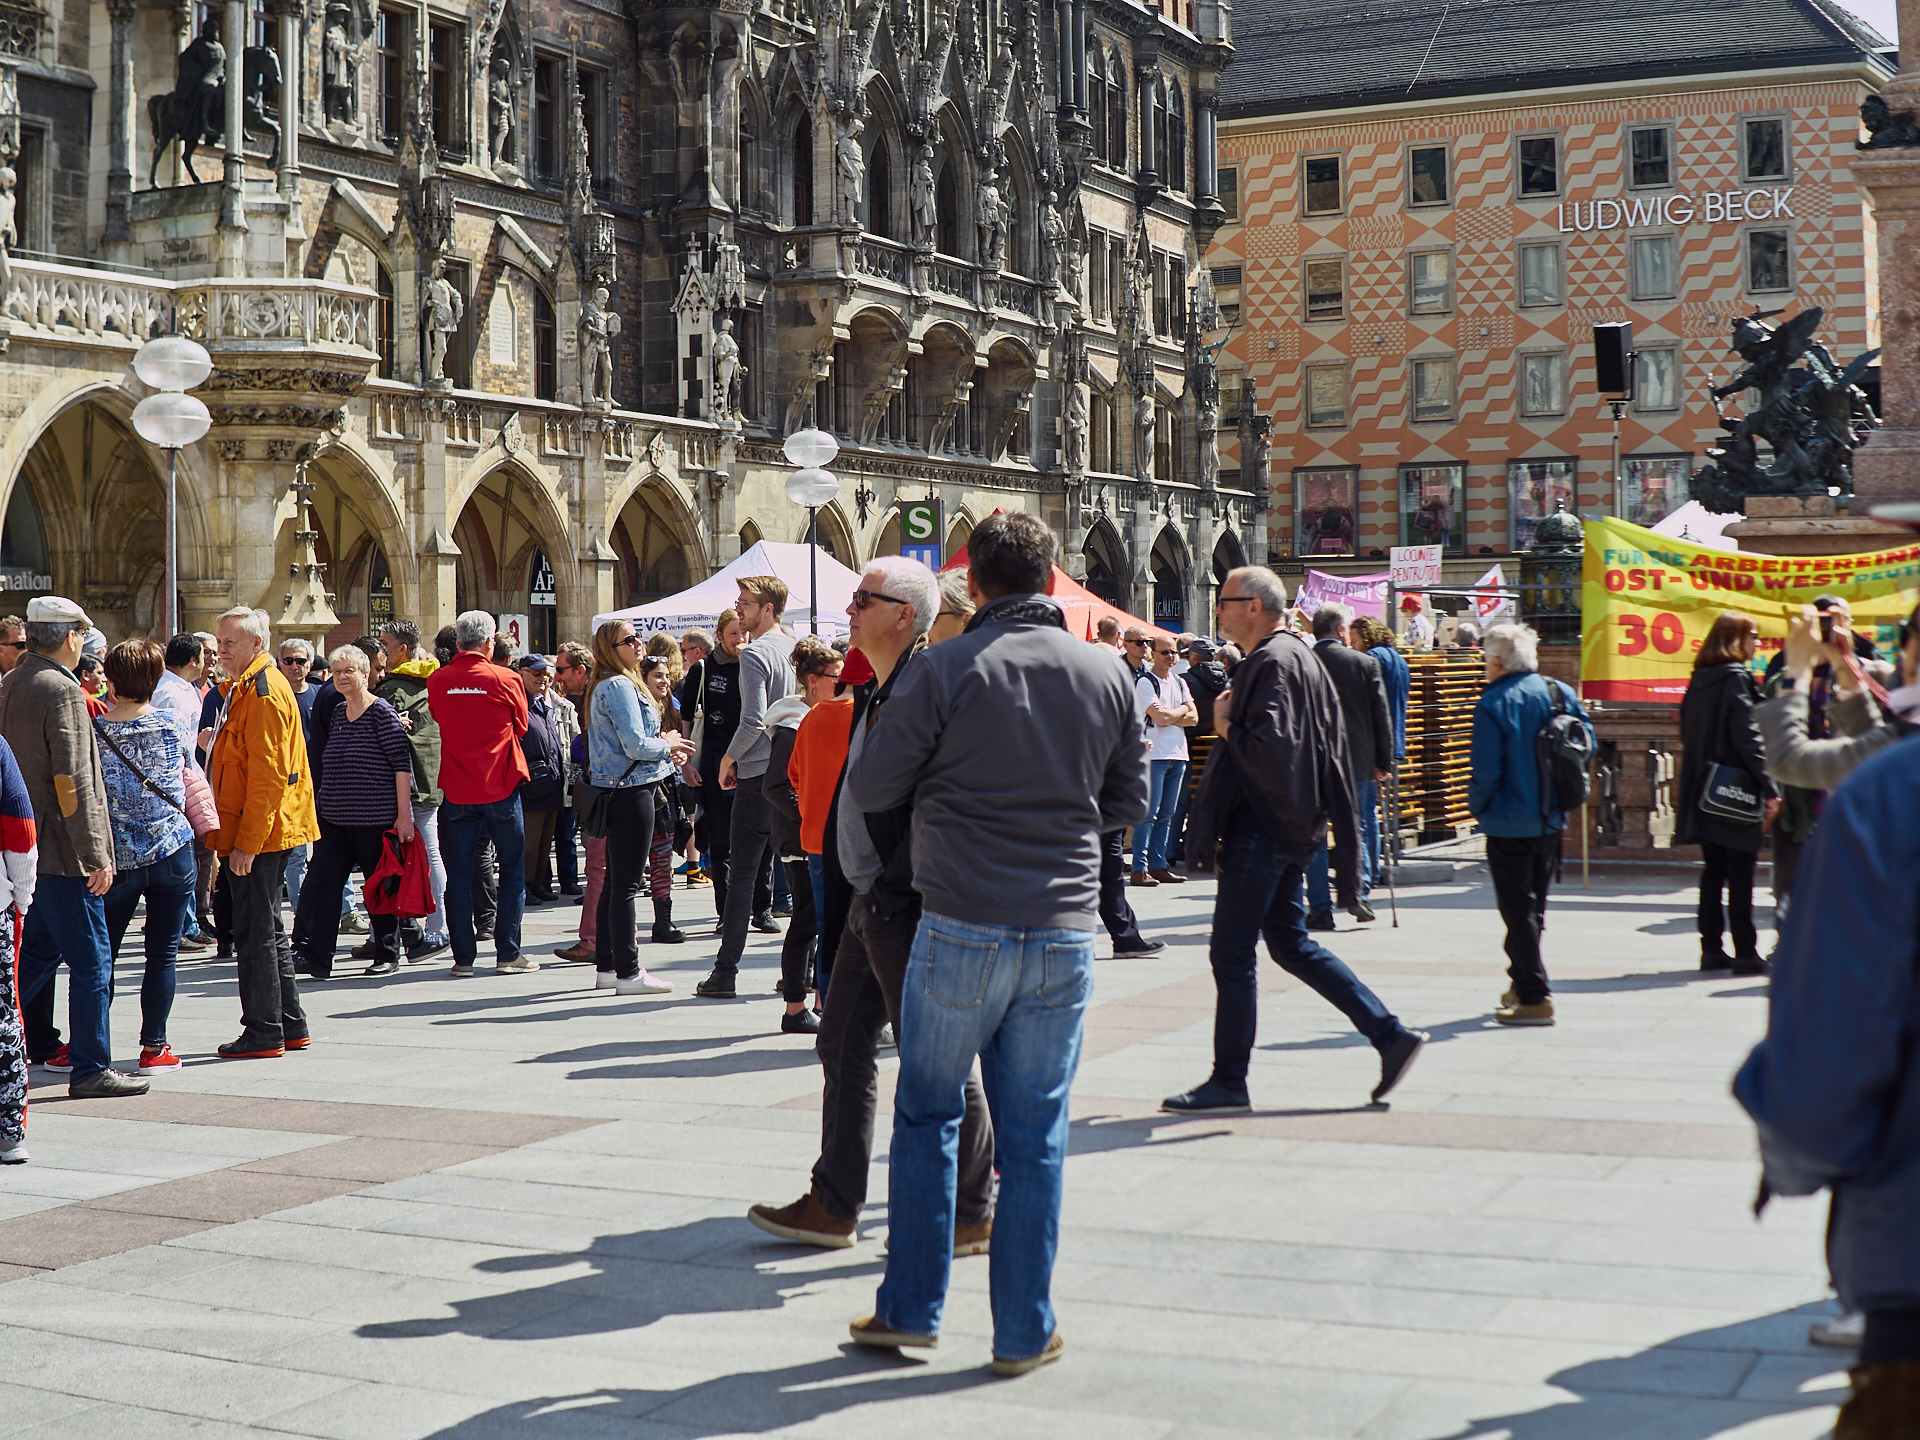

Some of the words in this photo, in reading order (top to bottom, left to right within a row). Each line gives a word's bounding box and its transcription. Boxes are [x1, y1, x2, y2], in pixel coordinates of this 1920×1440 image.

[1558, 194, 1694, 232] LUDWIG
[1705, 188, 1795, 222] BECK
[909, 506, 932, 539] S
[1604, 549, 1645, 565] FÜR
[1648, 550, 1685, 566] DIE
[1605, 569, 1682, 592] OST-
[1688, 570, 1755, 592] UND
[633, 617, 667, 631] EVG
[1618, 612, 1684, 656] 30
